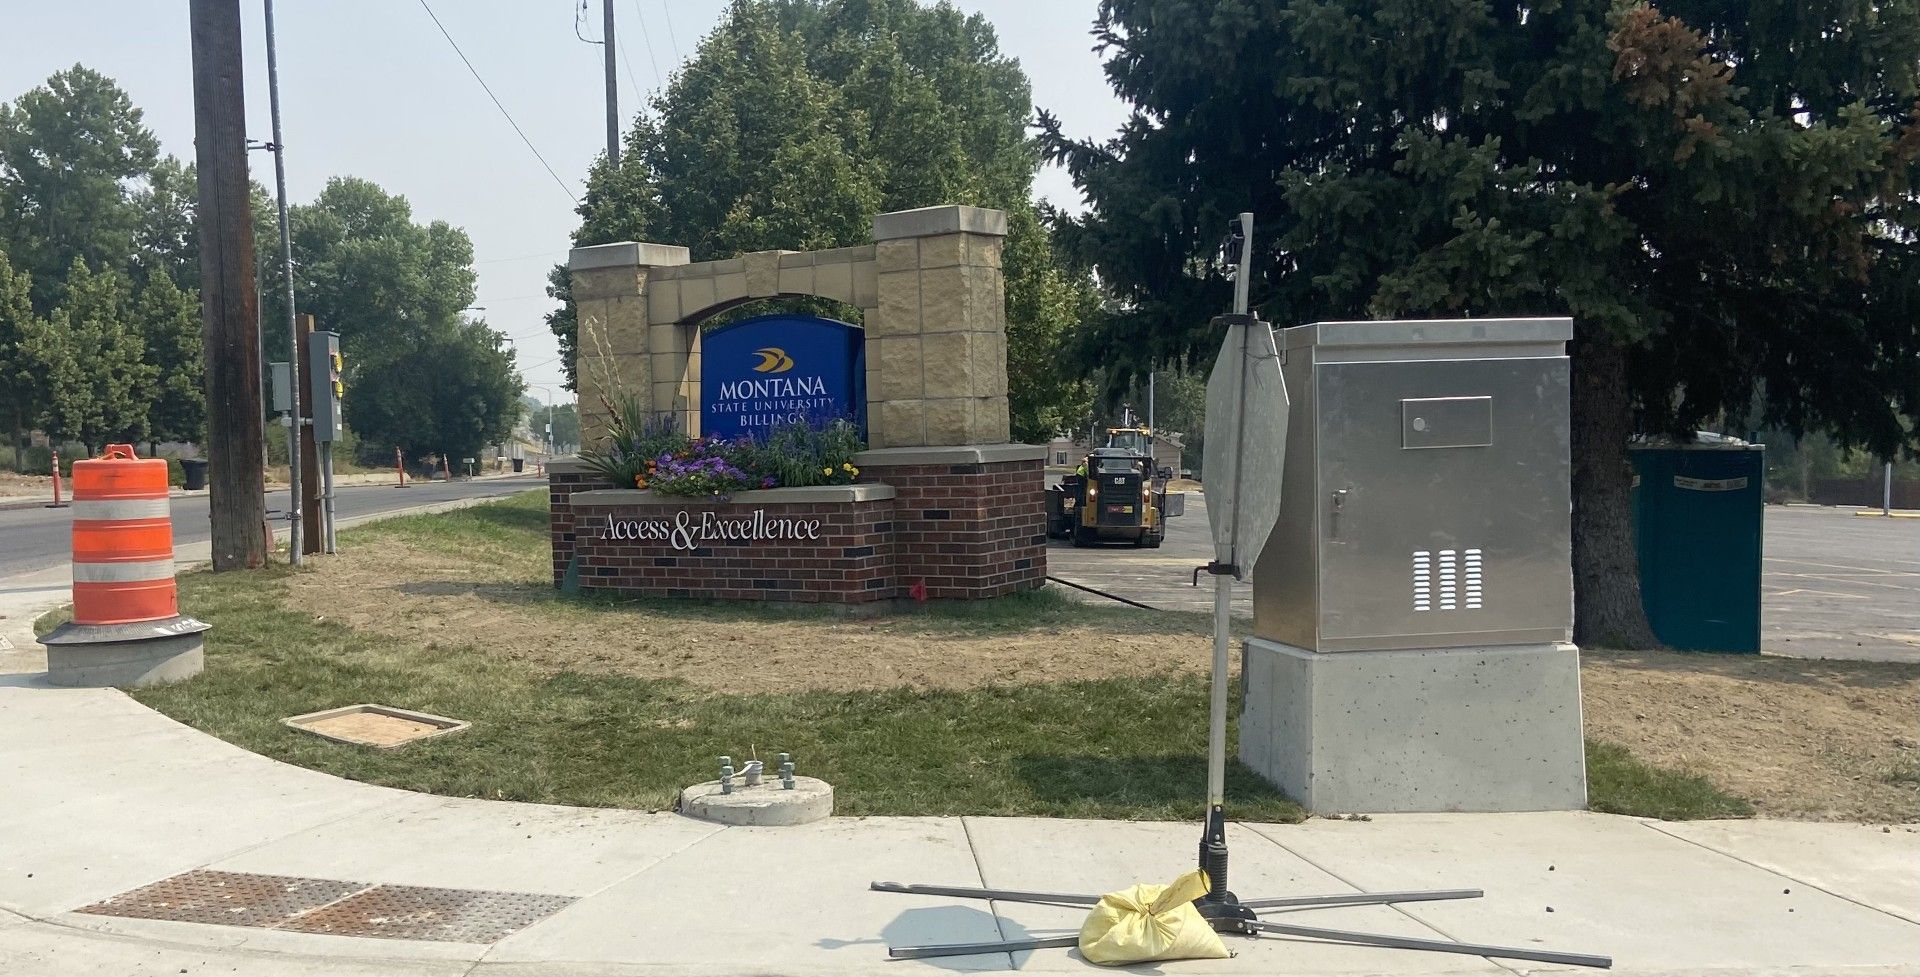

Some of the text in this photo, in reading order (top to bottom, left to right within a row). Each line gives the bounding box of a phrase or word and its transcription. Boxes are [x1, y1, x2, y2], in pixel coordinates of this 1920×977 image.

[719, 376, 827, 400] MONTANA
[711, 398, 835, 413] STATE UNIVERSITY
[601, 509, 821, 550] Access & Excellence
